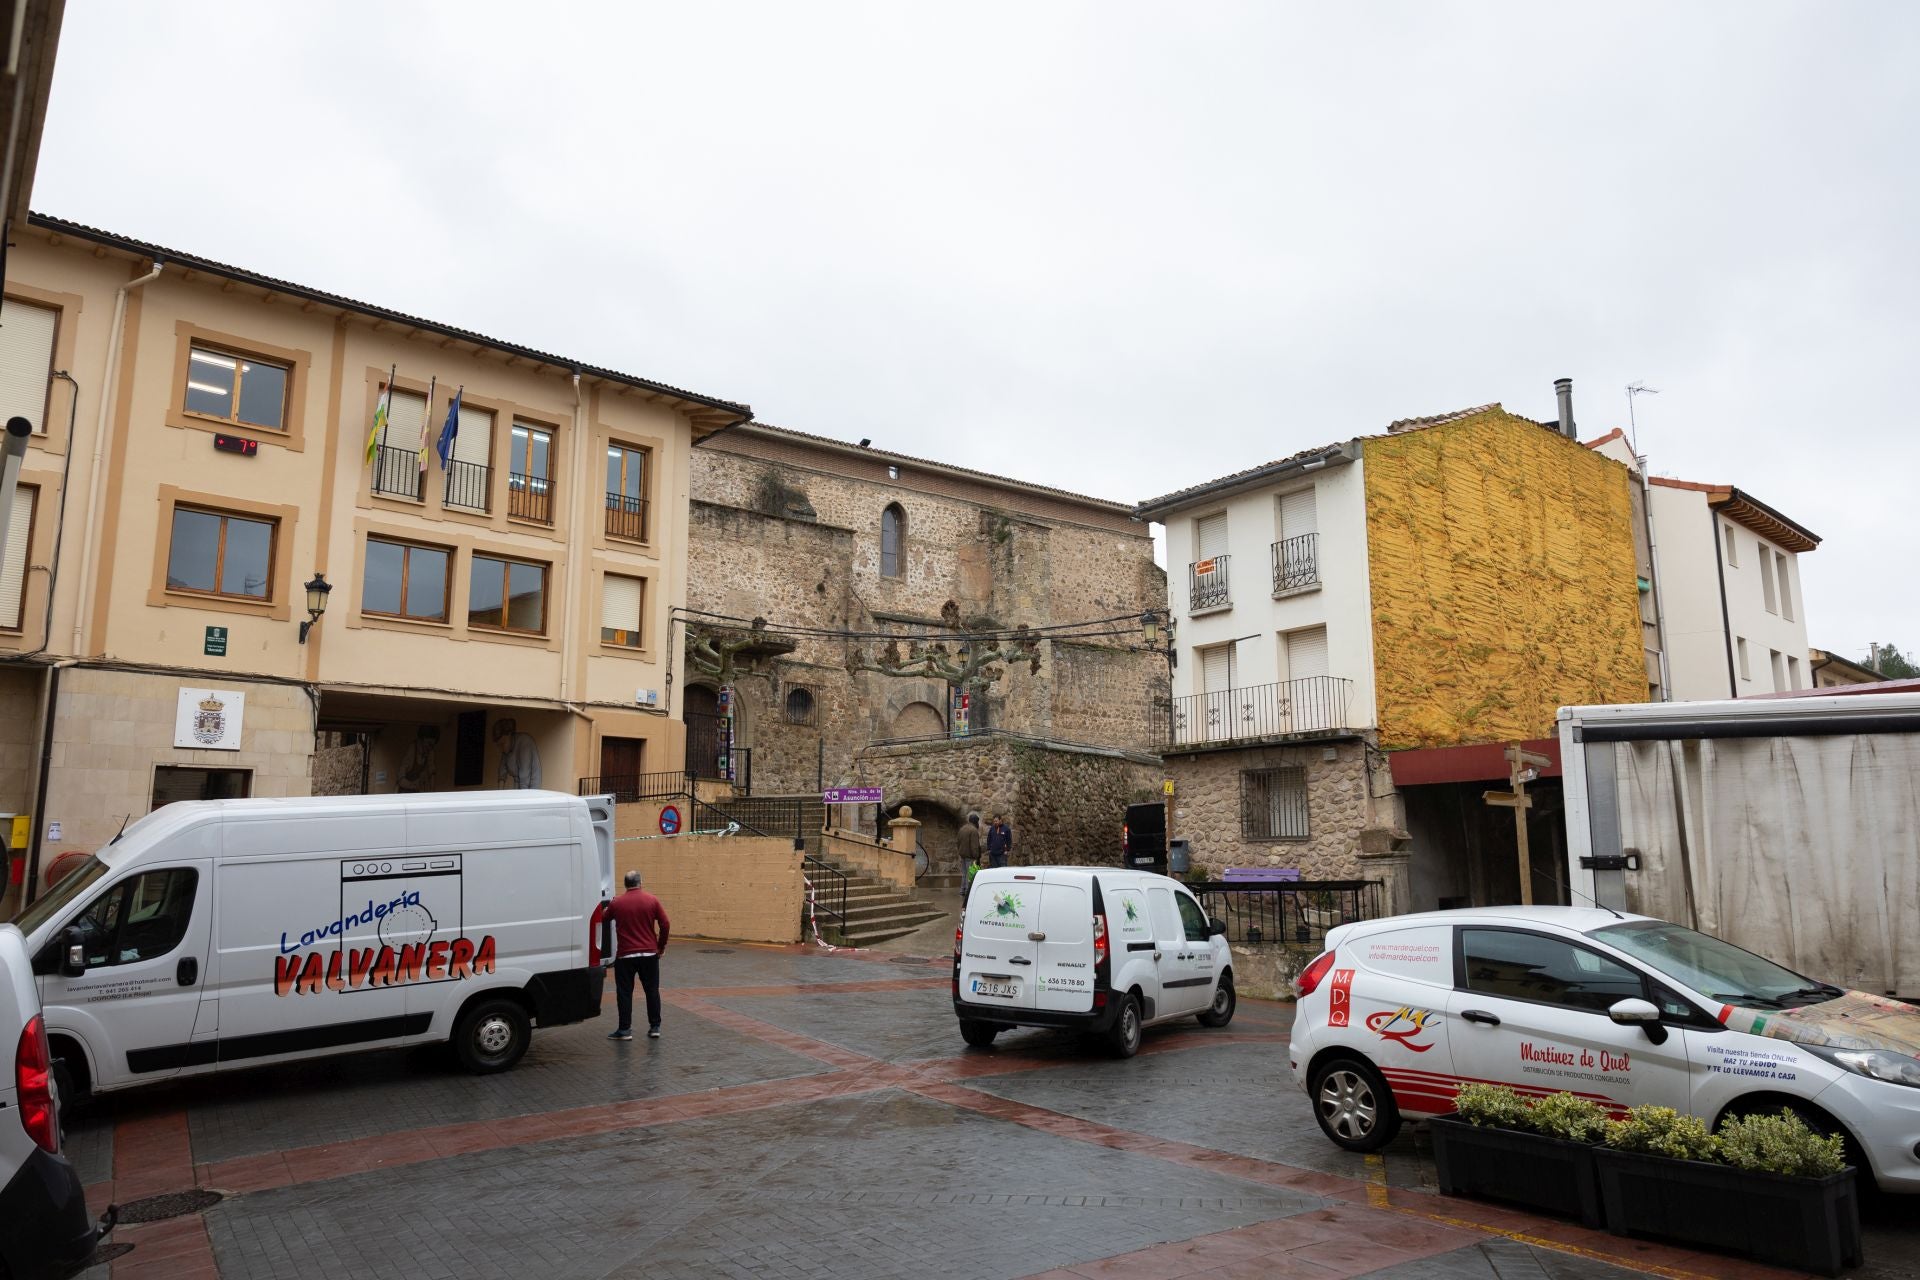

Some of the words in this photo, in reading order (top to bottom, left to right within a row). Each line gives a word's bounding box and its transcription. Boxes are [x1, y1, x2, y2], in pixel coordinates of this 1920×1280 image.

[281, 890, 420, 954] Lavandería
[274, 935, 496, 997] VALVANERA
[1368, 953, 1438, 963] info@mardequel.com
[1000, 984, 1018, 995] JXS
[1580, 1048, 1595, 1068] de
[1600, 1049, 1632, 1072] Quel
[1706, 1045, 1724, 1054] Visita
[1725, 1048, 1749, 1057] nuestra
[1750, 1051, 1770, 1060] tienda
[1771, 1053, 1798, 1064] ONLINE
[1723, 1057, 1737, 1065] HAZ
[1739, 1058, 1748, 1066] TU
[1750, 1060, 1777, 1069] PEDIDO
[1523, 1066, 1555, 1076] DISTRIBUCIÓN
[1564, 1071, 1594, 1081] PRODUCTOS
[1594, 1074, 1631, 1085] CONGELADOS
[1713, 1065, 1721, 1073] TE
[1723, 1066, 1731, 1074] LO
[1733, 1068, 1770, 1078] LLEVAMOS
[1770, 1071, 1776, 1079] A
[1778, 1072, 1796, 1081] CASA
